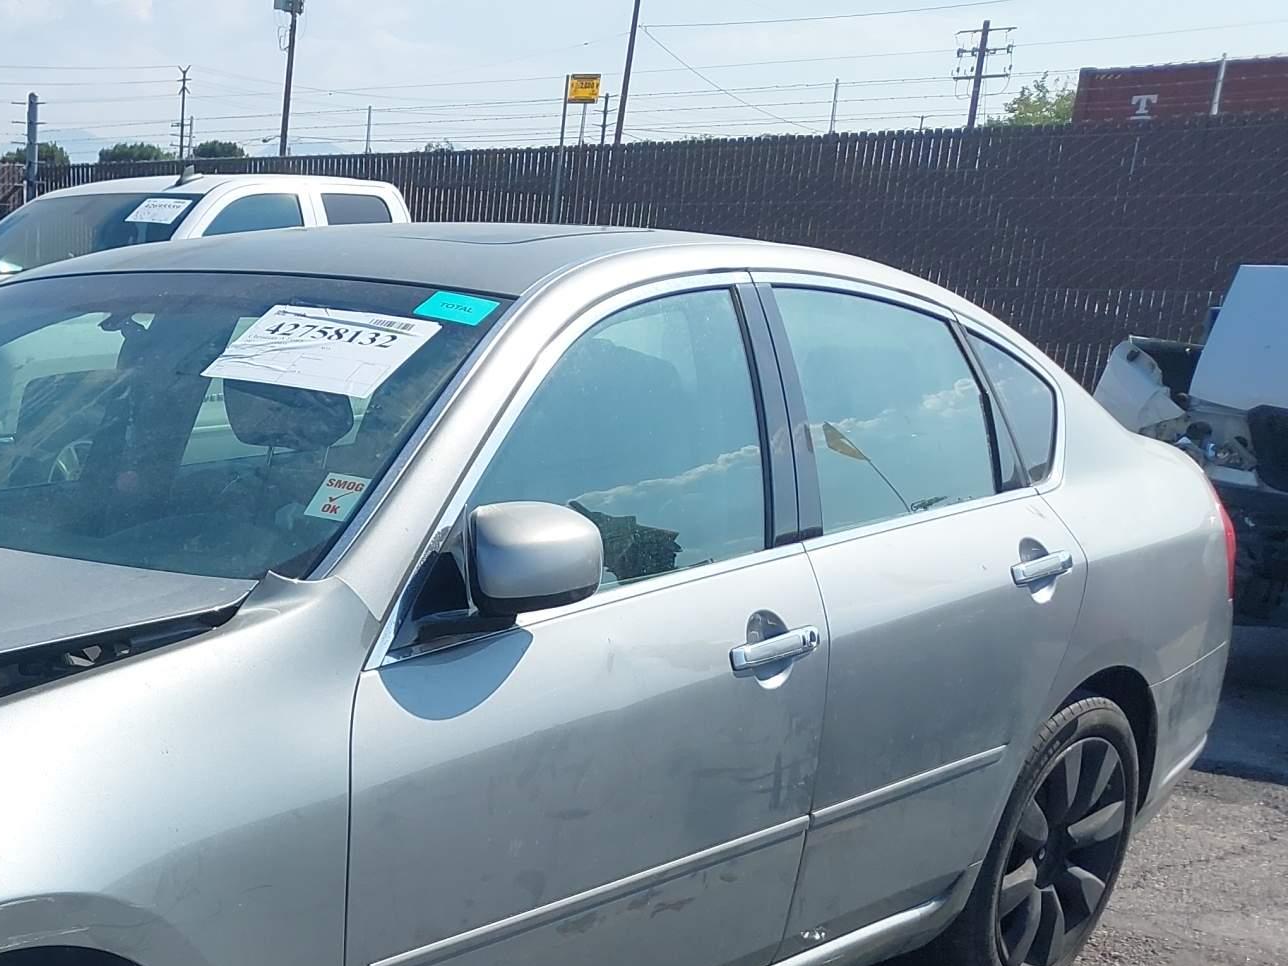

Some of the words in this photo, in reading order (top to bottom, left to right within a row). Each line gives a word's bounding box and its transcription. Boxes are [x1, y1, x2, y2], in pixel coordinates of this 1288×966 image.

[440, 302, 472, 313] TOTAL
[265, 322, 398, 348] 42758132
[326, 478, 365, 492] SMOG
[321, 504, 340, 514] OK
